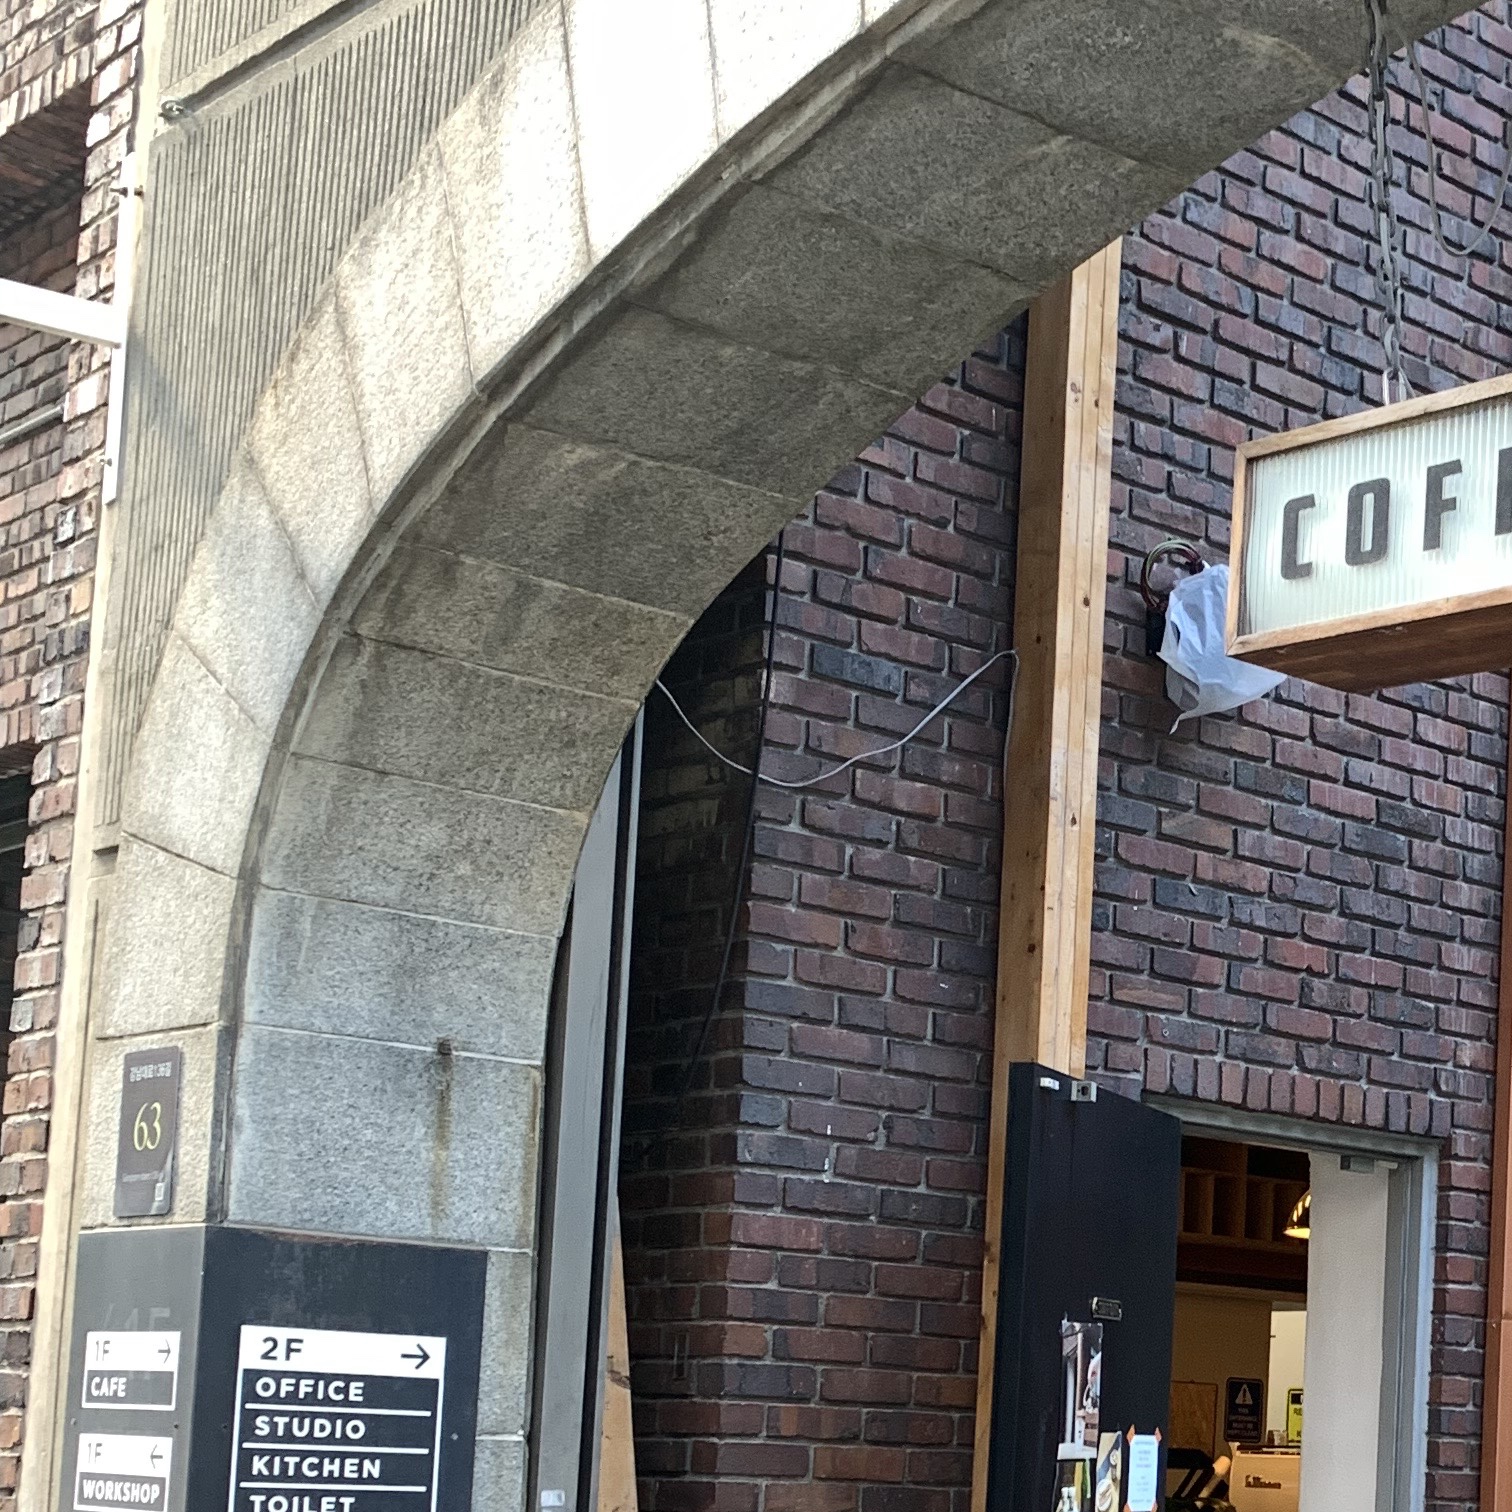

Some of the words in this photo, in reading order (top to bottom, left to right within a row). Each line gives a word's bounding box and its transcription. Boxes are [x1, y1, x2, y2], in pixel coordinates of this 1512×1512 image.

[133, 1101, 162, 1151] 63
[95, 1340, 110, 1362] 1F
[260, 1336, 304, 1362] 2F
[90, 1376, 127, 1398] CAFE
[255, 1376, 365, 1402] OFFICE
[254, 1415, 366, 1440] STUDIO
[87, 1442, 103, 1464] 1F
[251, 1454, 381, 1479] KITCHEN
[83, 1478, 161, 1504] WORKSHOP
